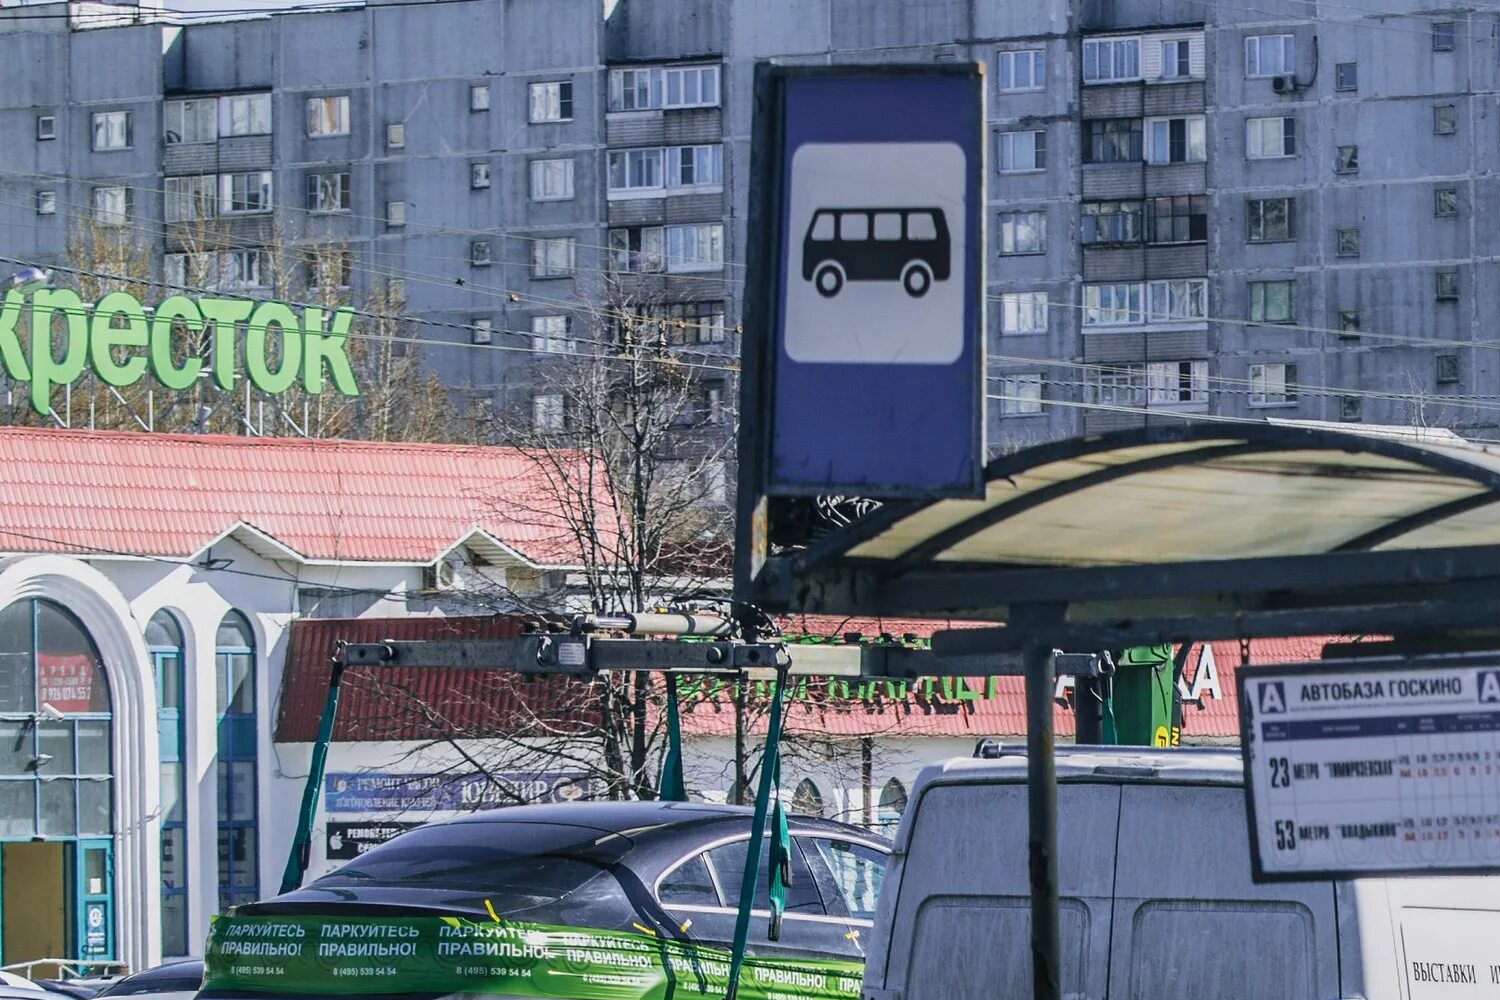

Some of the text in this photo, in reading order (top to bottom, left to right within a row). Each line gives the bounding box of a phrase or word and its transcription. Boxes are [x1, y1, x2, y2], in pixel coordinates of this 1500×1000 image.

[1301, 677, 1462, 702] АВТОБАЗА ГОСКИНО
[1270, 757, 1291, 788] 23
[1275, 820, 1296, 851] 53
[226, 920, 306, 938] ПАРКУЙТЕСЬ
[320, 922, 420, 938] ПАРКУЙТЕСЬ
[221, 940, 302, 957] ПРАВИЛЬНО!
[319, 942, 417, 957] ПРАВИЛЬНО!
[566, 948, 653, 969] ПРАВИЛЬНО!
[266, 966, 274, 975] 54
[276, 967, 284, 976] 54
[333, 967, 397, 977] 8 (495) 539 54 54
[456, 966, 532, 978] 8 (495) 539 54 54
[754, 966, 826, 989] ПРАВИЛЬНО!
[1413, 962, 1477, 984] ВЫСТАВКИ
